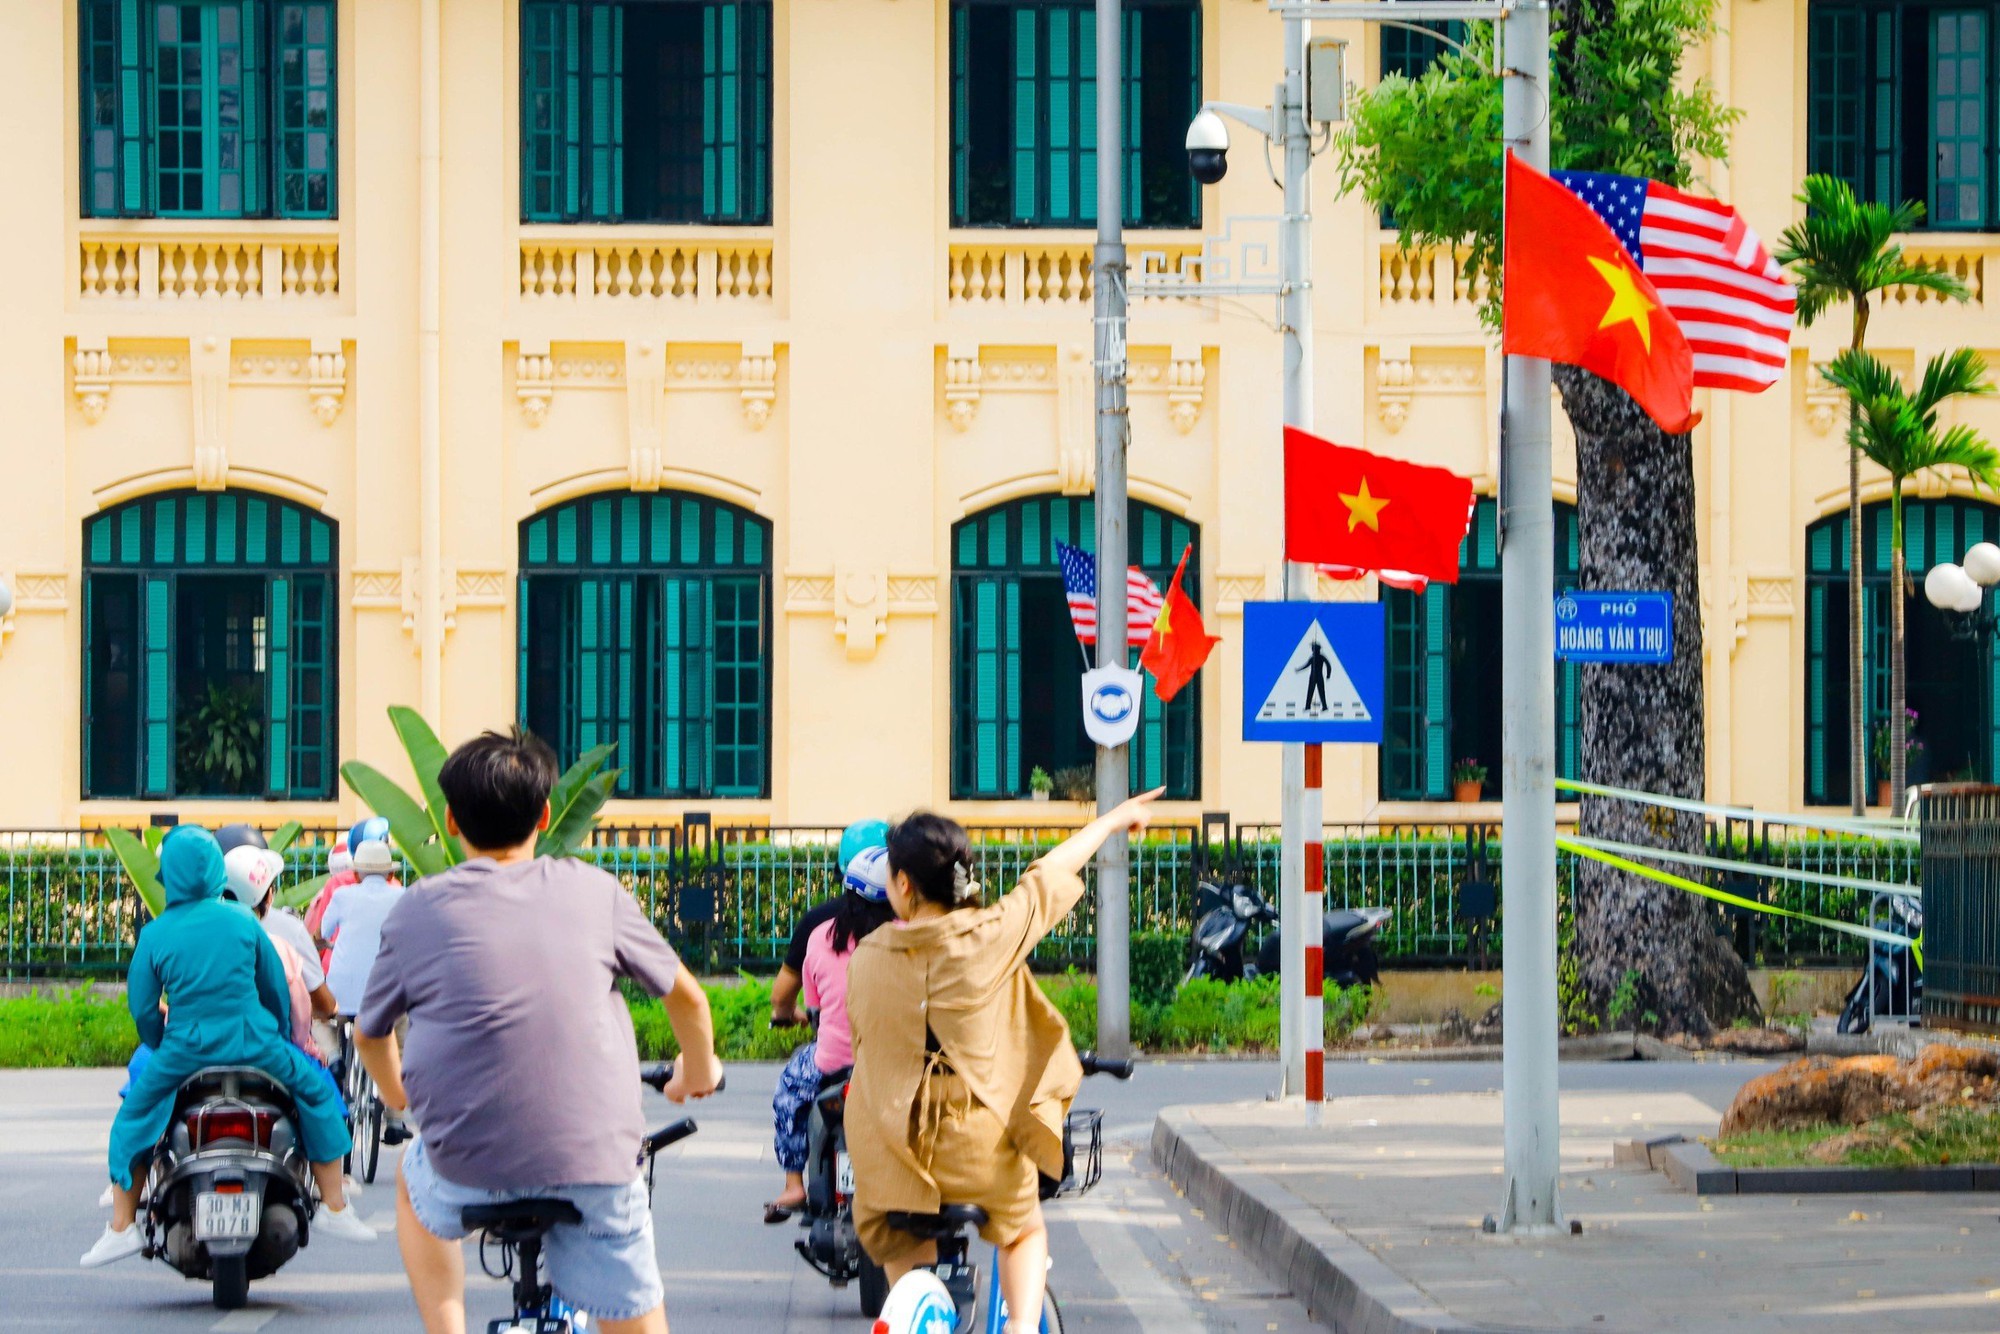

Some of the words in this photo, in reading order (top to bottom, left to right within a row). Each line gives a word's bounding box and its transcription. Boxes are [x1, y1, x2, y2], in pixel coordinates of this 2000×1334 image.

[1600, 597, 1637, 616] PHỐ
[1560, 621, 1603, 651] HOÀNG
[1608, 621, 1634, 651] VĂN
[1639, 626, 1663, 656] THỤ
